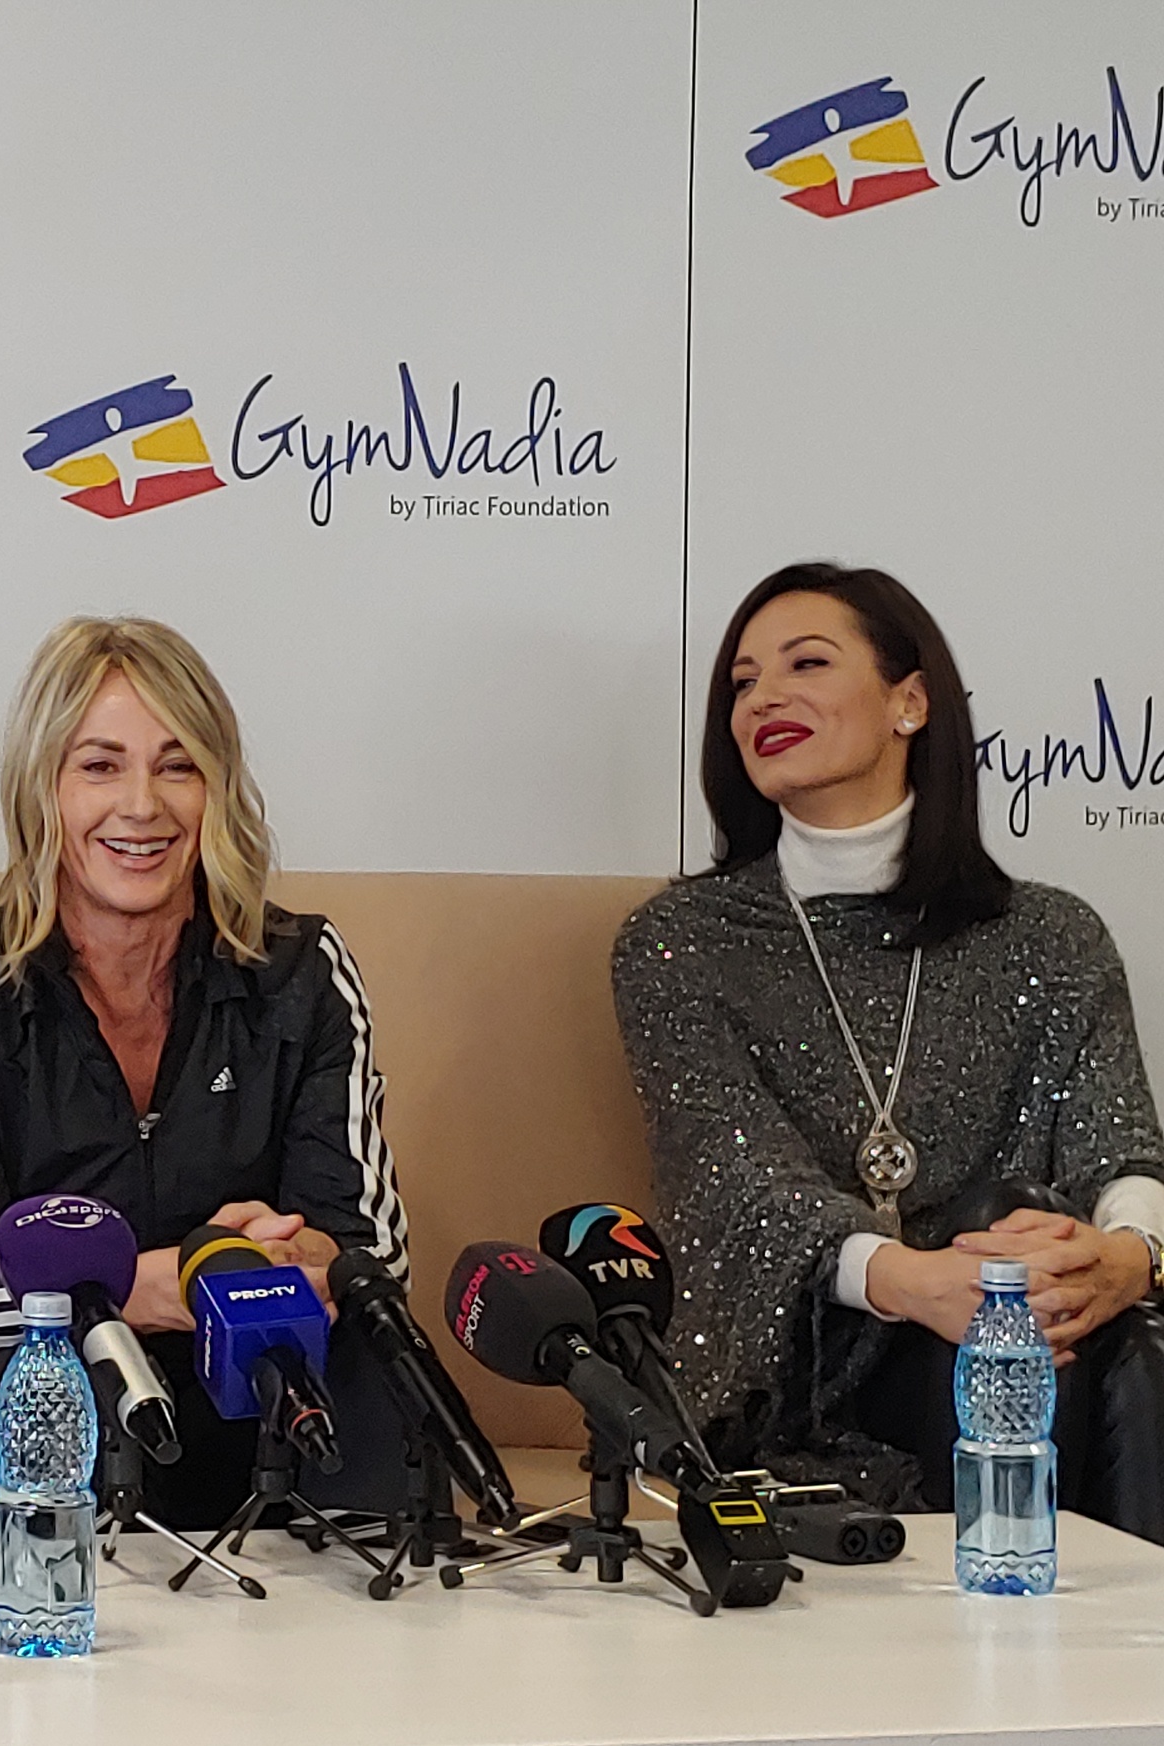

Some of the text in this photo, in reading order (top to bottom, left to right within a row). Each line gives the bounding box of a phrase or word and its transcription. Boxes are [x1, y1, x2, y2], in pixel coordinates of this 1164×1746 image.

[945, 66, 1164, 227] GymN
[1097, 196, 1122, 223] by
[232, 362, 617, 526] GymNadia
[390, 494, 609, 522] by Tiriac Foundation
[1085, 805, 1110, 832] by
[588, 1258, 655, 1283] TVR
[463, 1293, 486, 1351] SPORT
